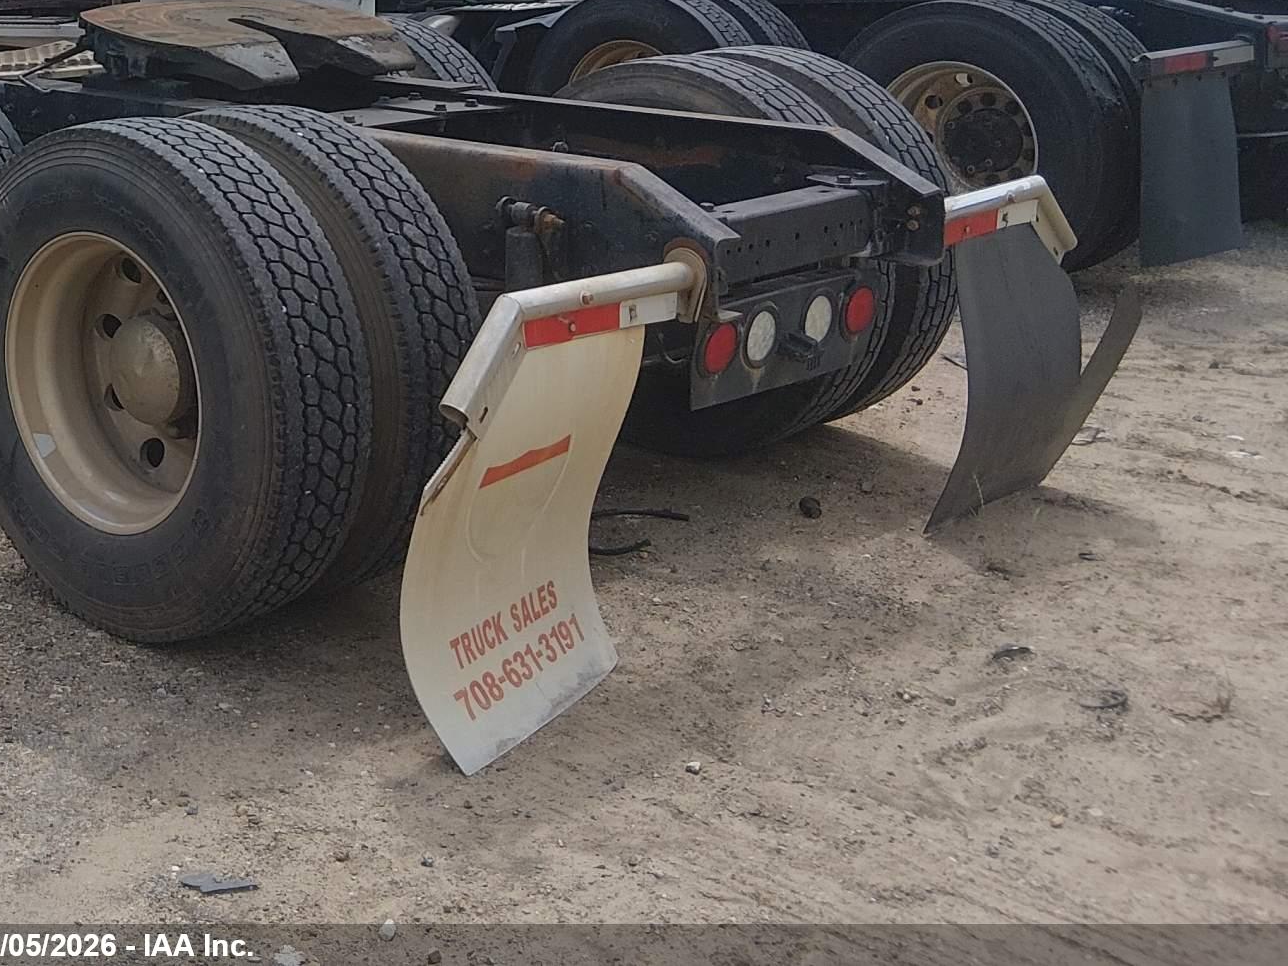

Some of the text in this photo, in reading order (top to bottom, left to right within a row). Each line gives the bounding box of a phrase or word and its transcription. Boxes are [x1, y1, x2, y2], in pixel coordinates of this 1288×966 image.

[449, 580, 559, 670] TRUCK SALES
[453, 613, 585, 721] 708-631-3191
